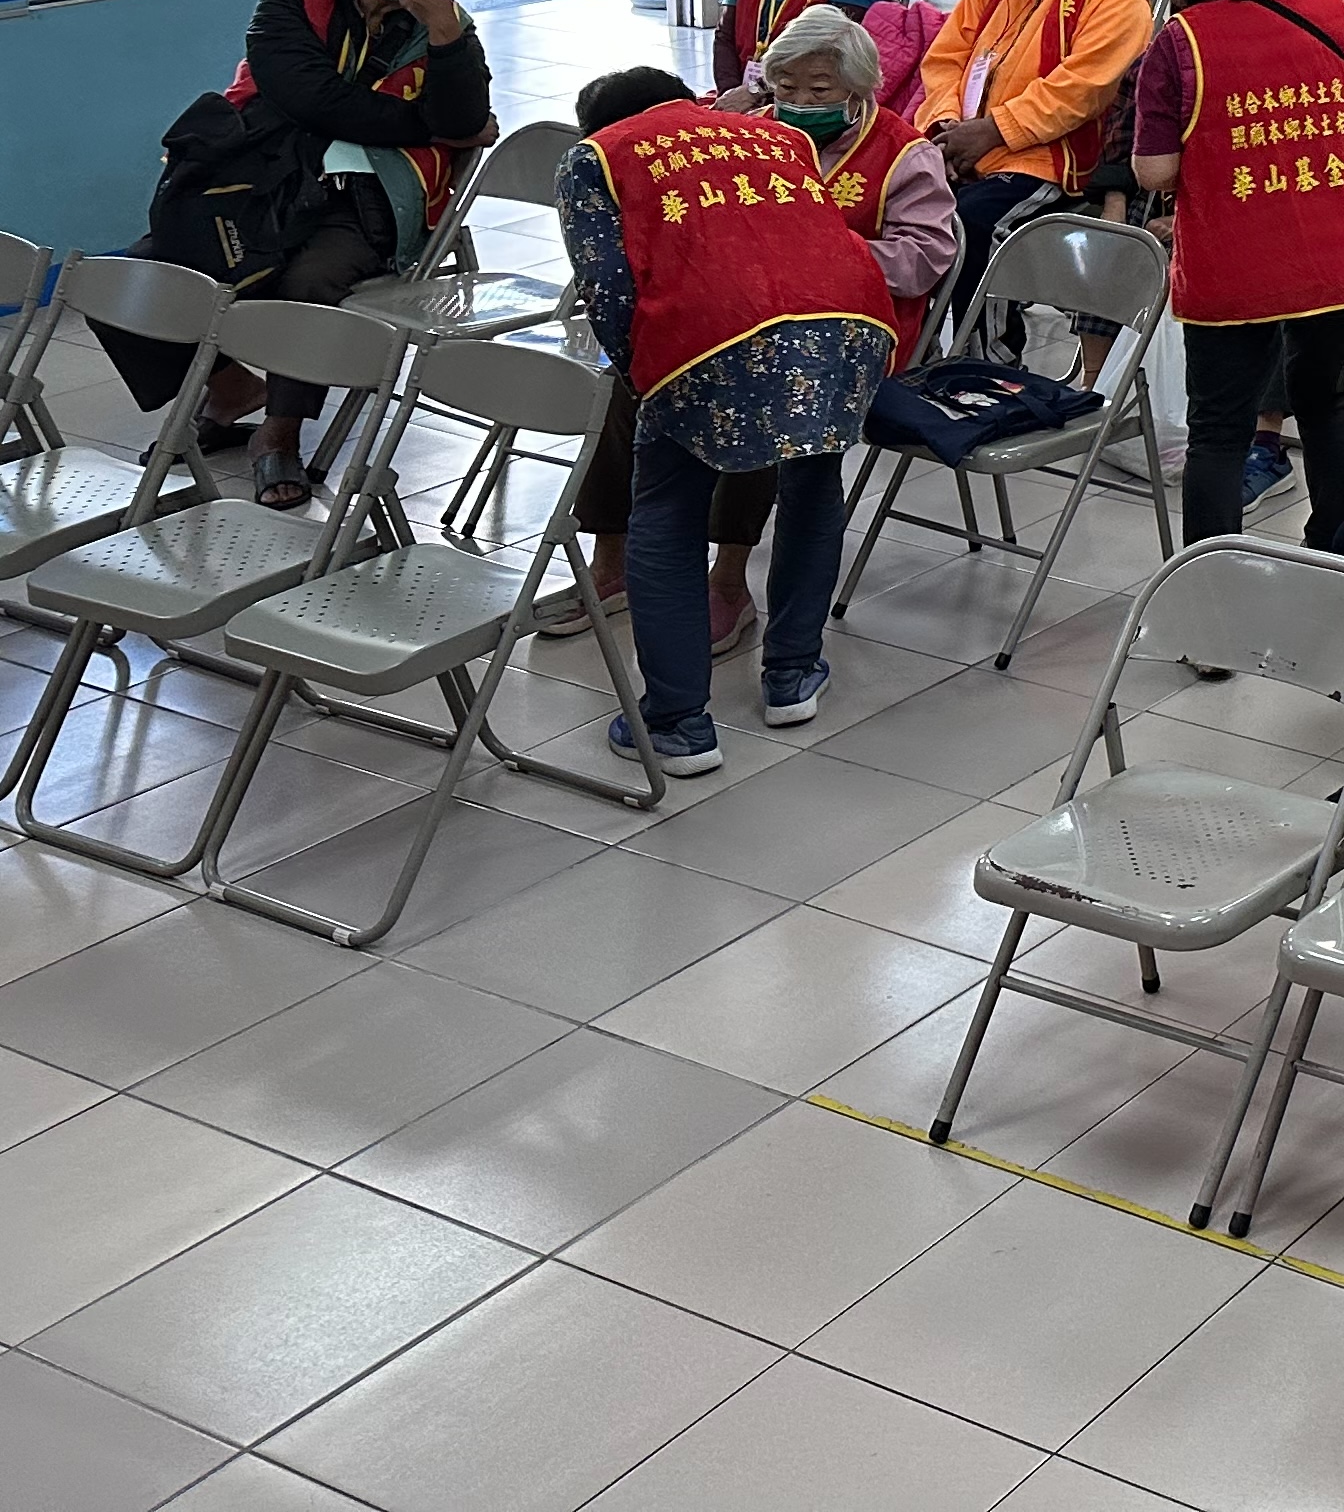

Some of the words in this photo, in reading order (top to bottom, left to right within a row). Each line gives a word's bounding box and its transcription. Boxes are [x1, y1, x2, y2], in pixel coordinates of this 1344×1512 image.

[661, 172, 826, 224] 華山基金會
